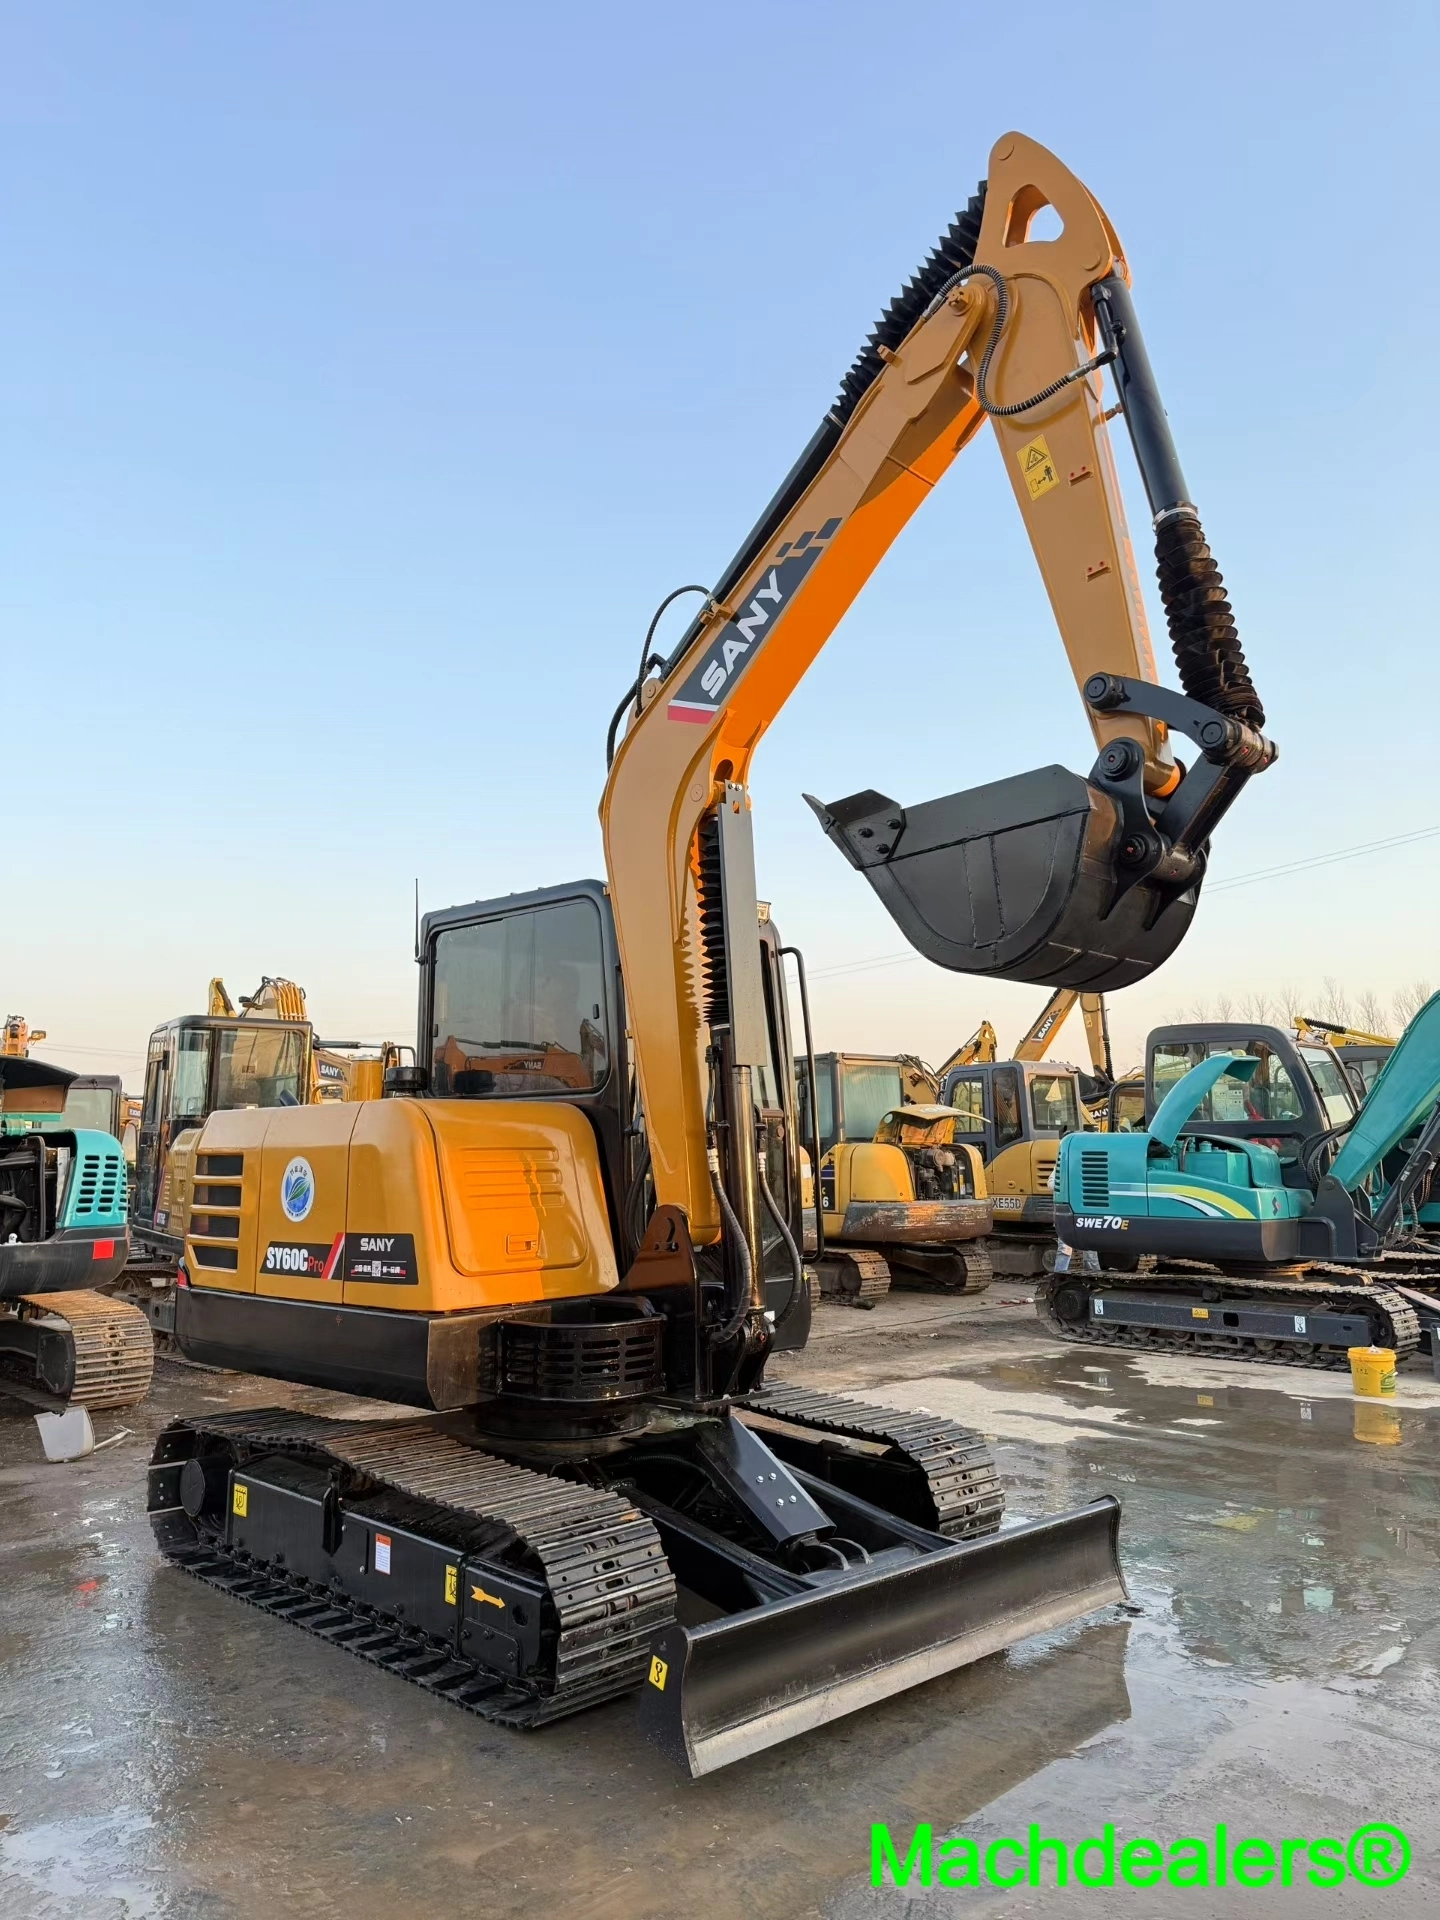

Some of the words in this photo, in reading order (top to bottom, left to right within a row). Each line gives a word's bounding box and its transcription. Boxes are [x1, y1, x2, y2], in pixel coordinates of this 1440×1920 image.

[701, 568, 783, 699] SANY
[1037, 1016, 1053, 1039] SANY
[320, 1064, 339, 1077] SANY
[992, 1197, 1021, 1209] XE55D
[1076, 1215, 1130, 1230] SWE70E
[360, 1237, 395, 1252] SANY
